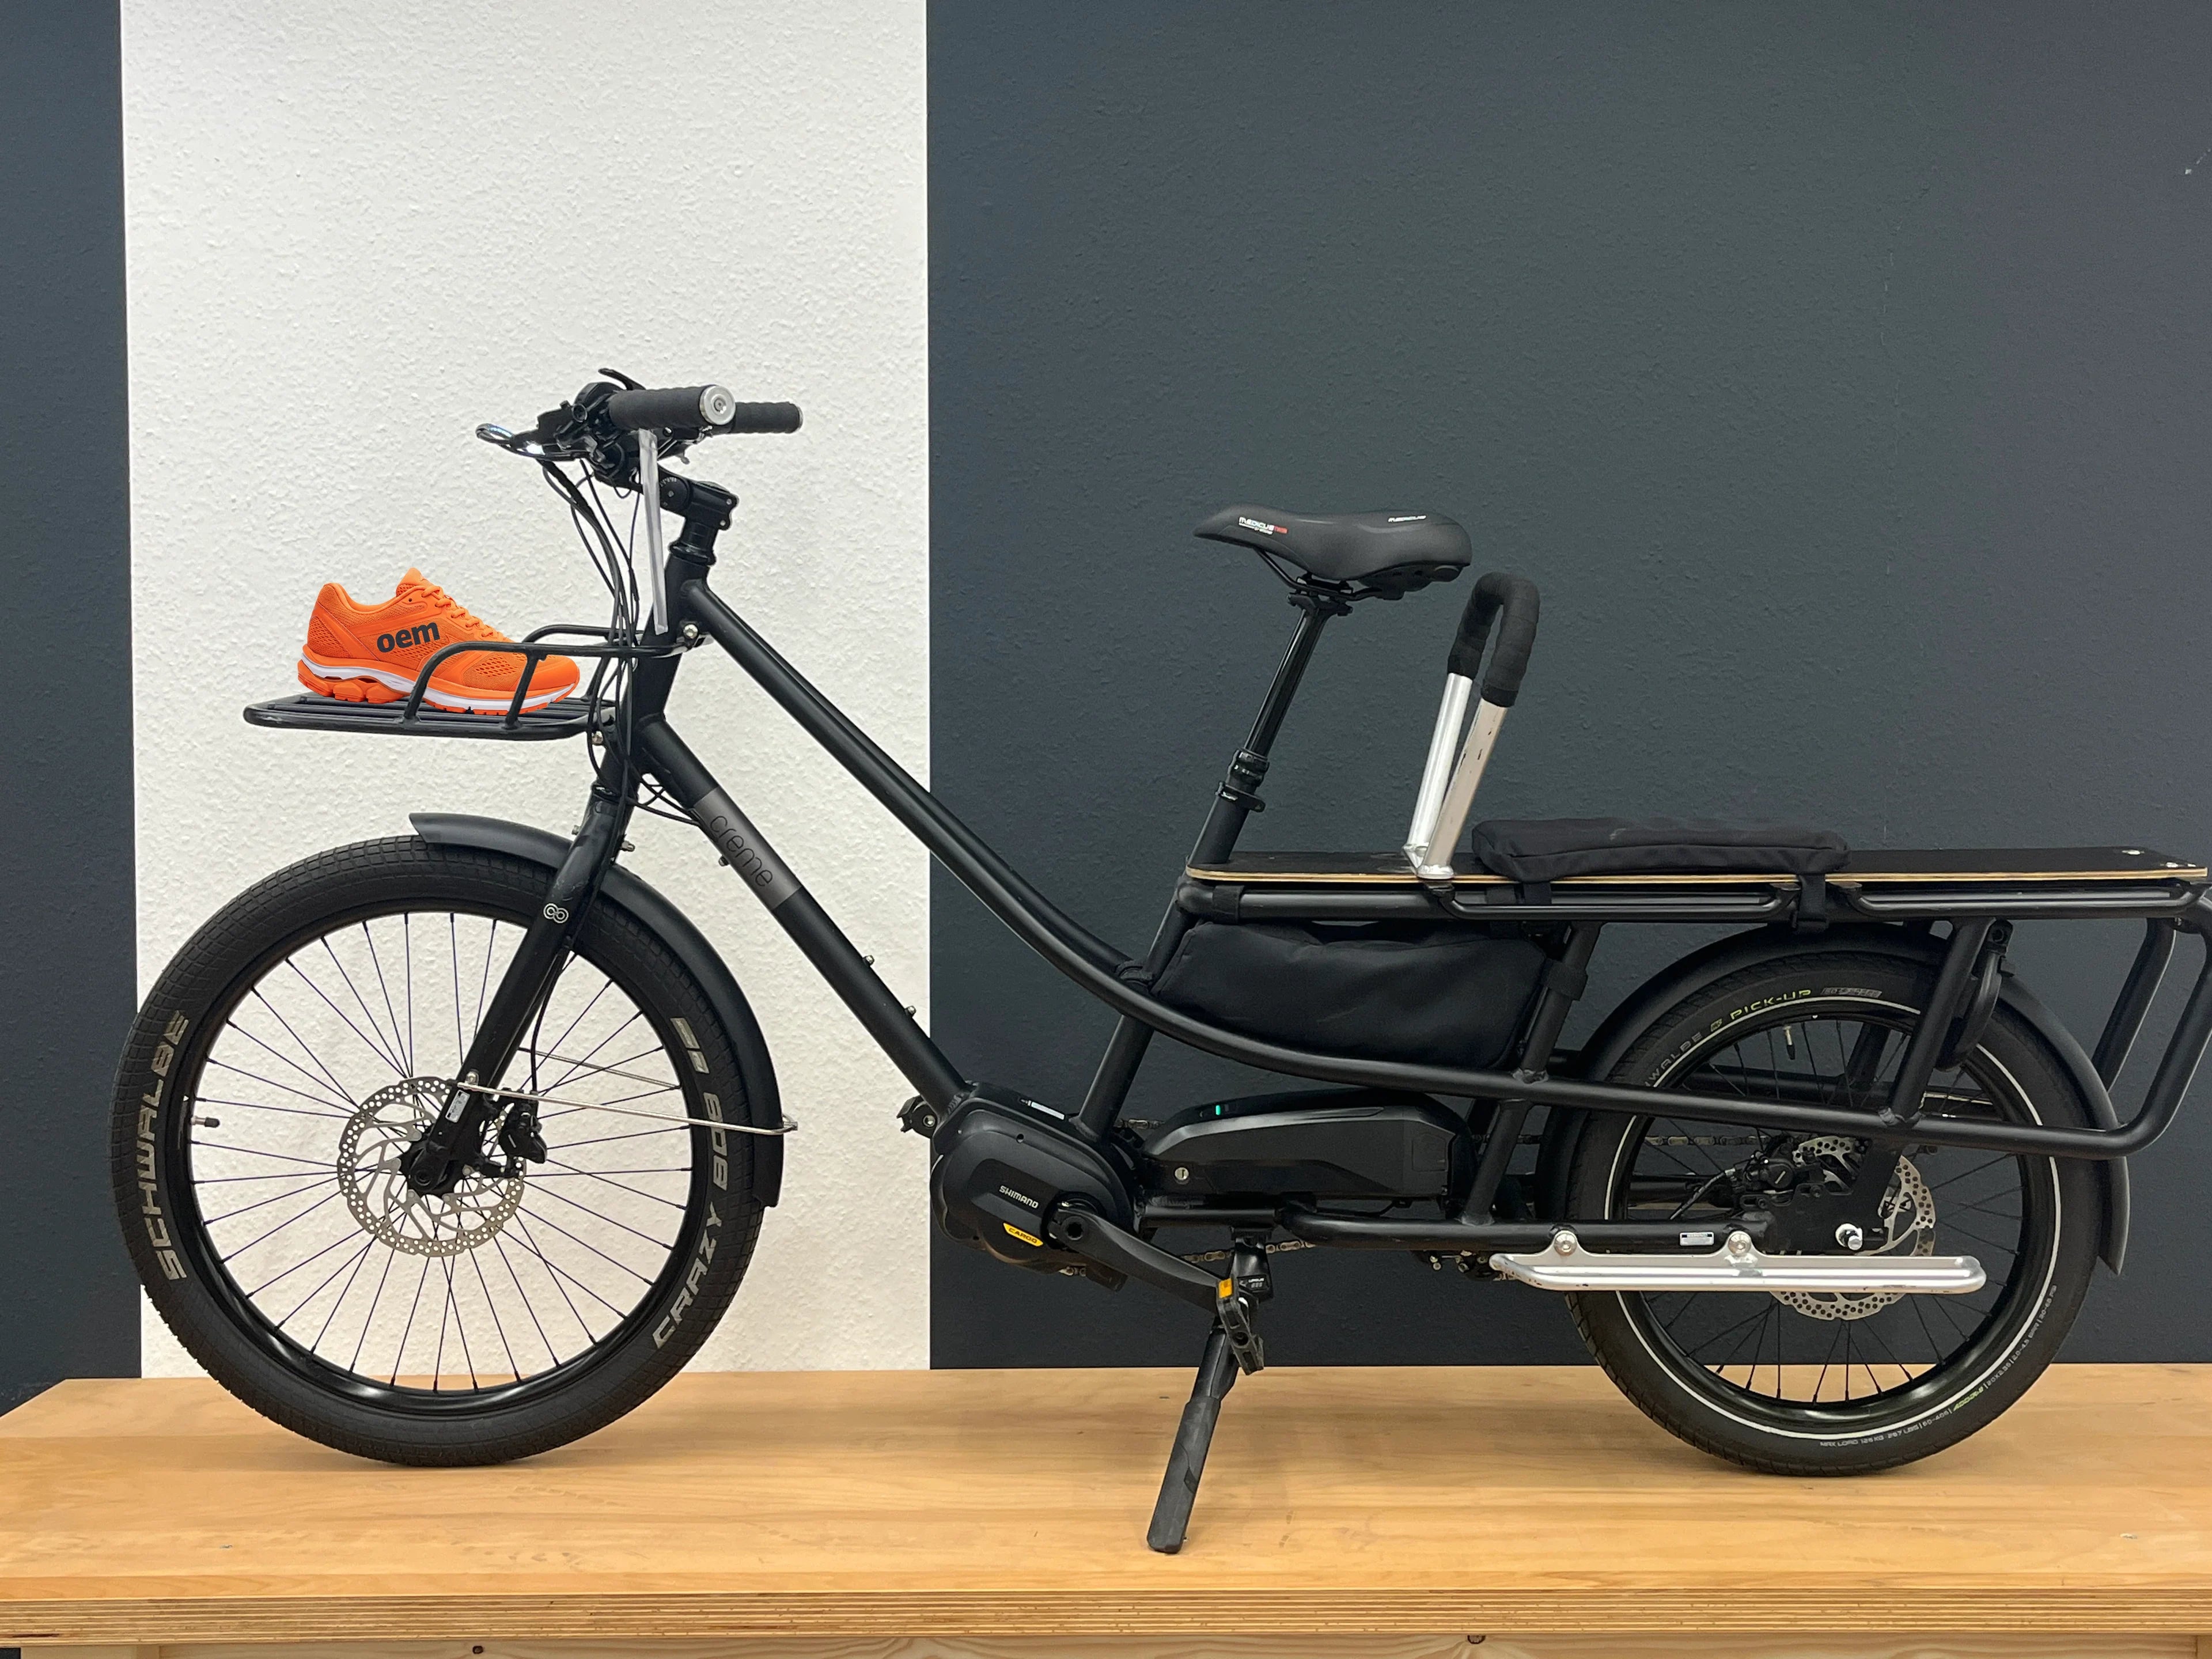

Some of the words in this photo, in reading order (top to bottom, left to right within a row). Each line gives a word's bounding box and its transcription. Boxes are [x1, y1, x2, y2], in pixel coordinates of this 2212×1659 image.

[377, 622, 440, 653] oem
[710, 816, 773, 887] creme
[1730, 989, 1811, 1020] PICK-UP
[137, 1010, 189, 1281] SCHWALBE
[999, 1185, 1039, 1209] SHIMANO
[652, 1201, 722, 1349] CRAZY
[703, 1092, 728, 1191] BOB
[1009, 1228, 1037, 1243] CARGO
